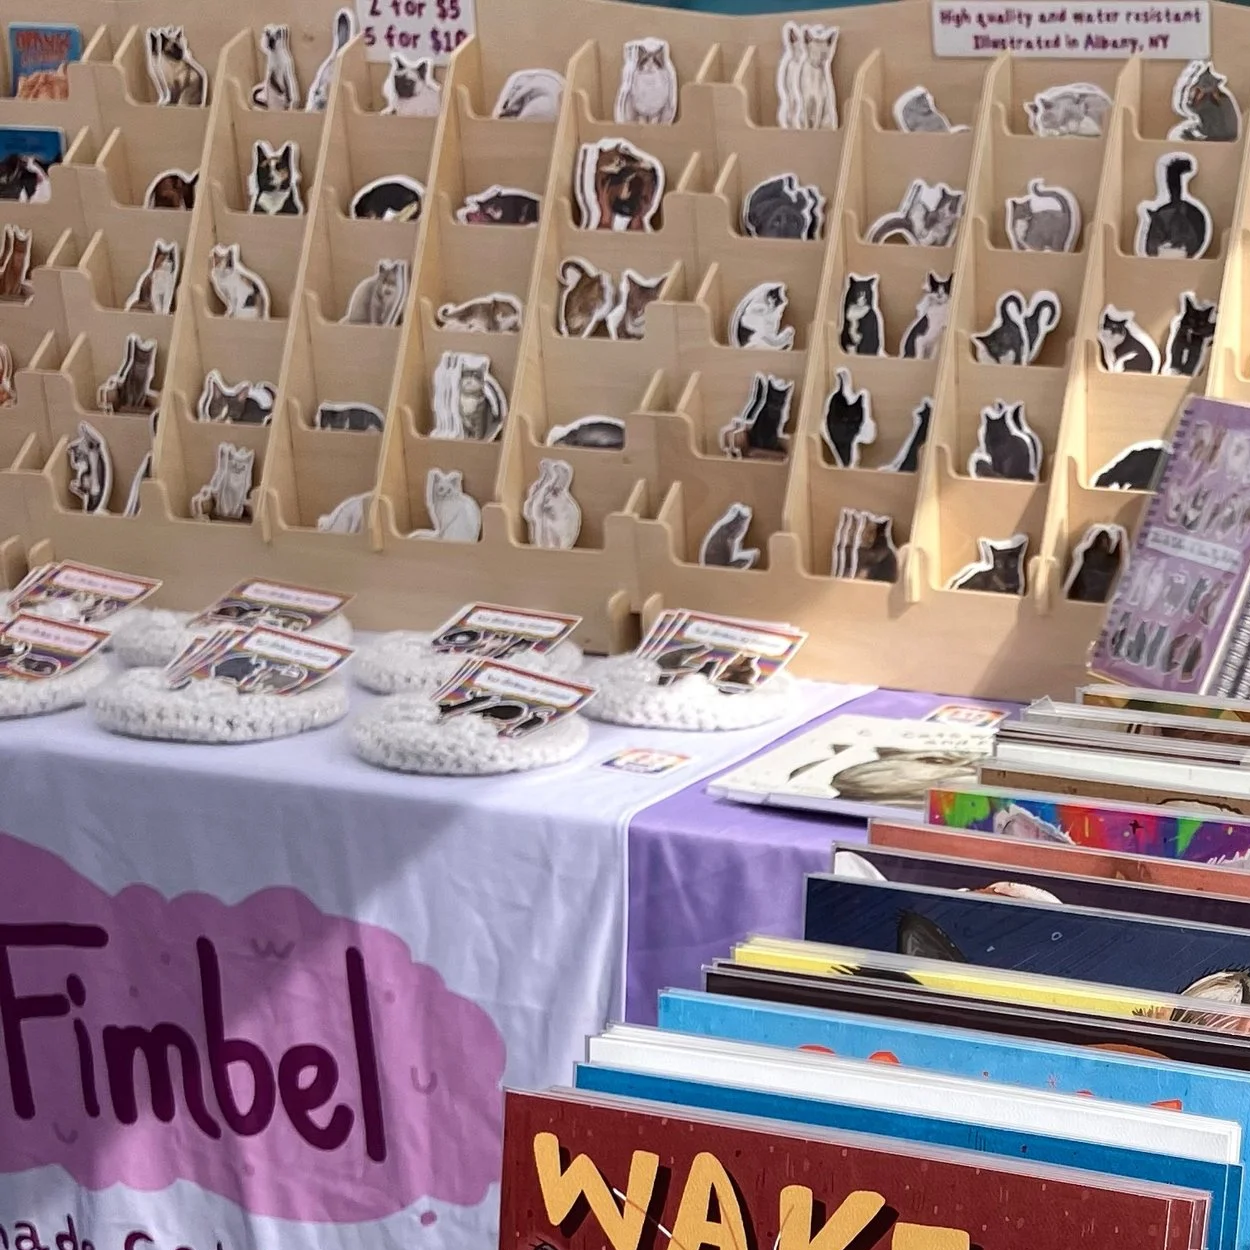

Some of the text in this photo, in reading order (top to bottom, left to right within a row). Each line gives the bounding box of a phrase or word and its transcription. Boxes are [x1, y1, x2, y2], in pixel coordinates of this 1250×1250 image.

[391, 0, 426, 17] for
[437, 0, 461, 20] $5
[939, 8, 1202, 28] High quality and water resistant
[364, 24, 468, 54] 5 for $10
[972, 34, 1170, 54] Illustrated in Albany, NY
